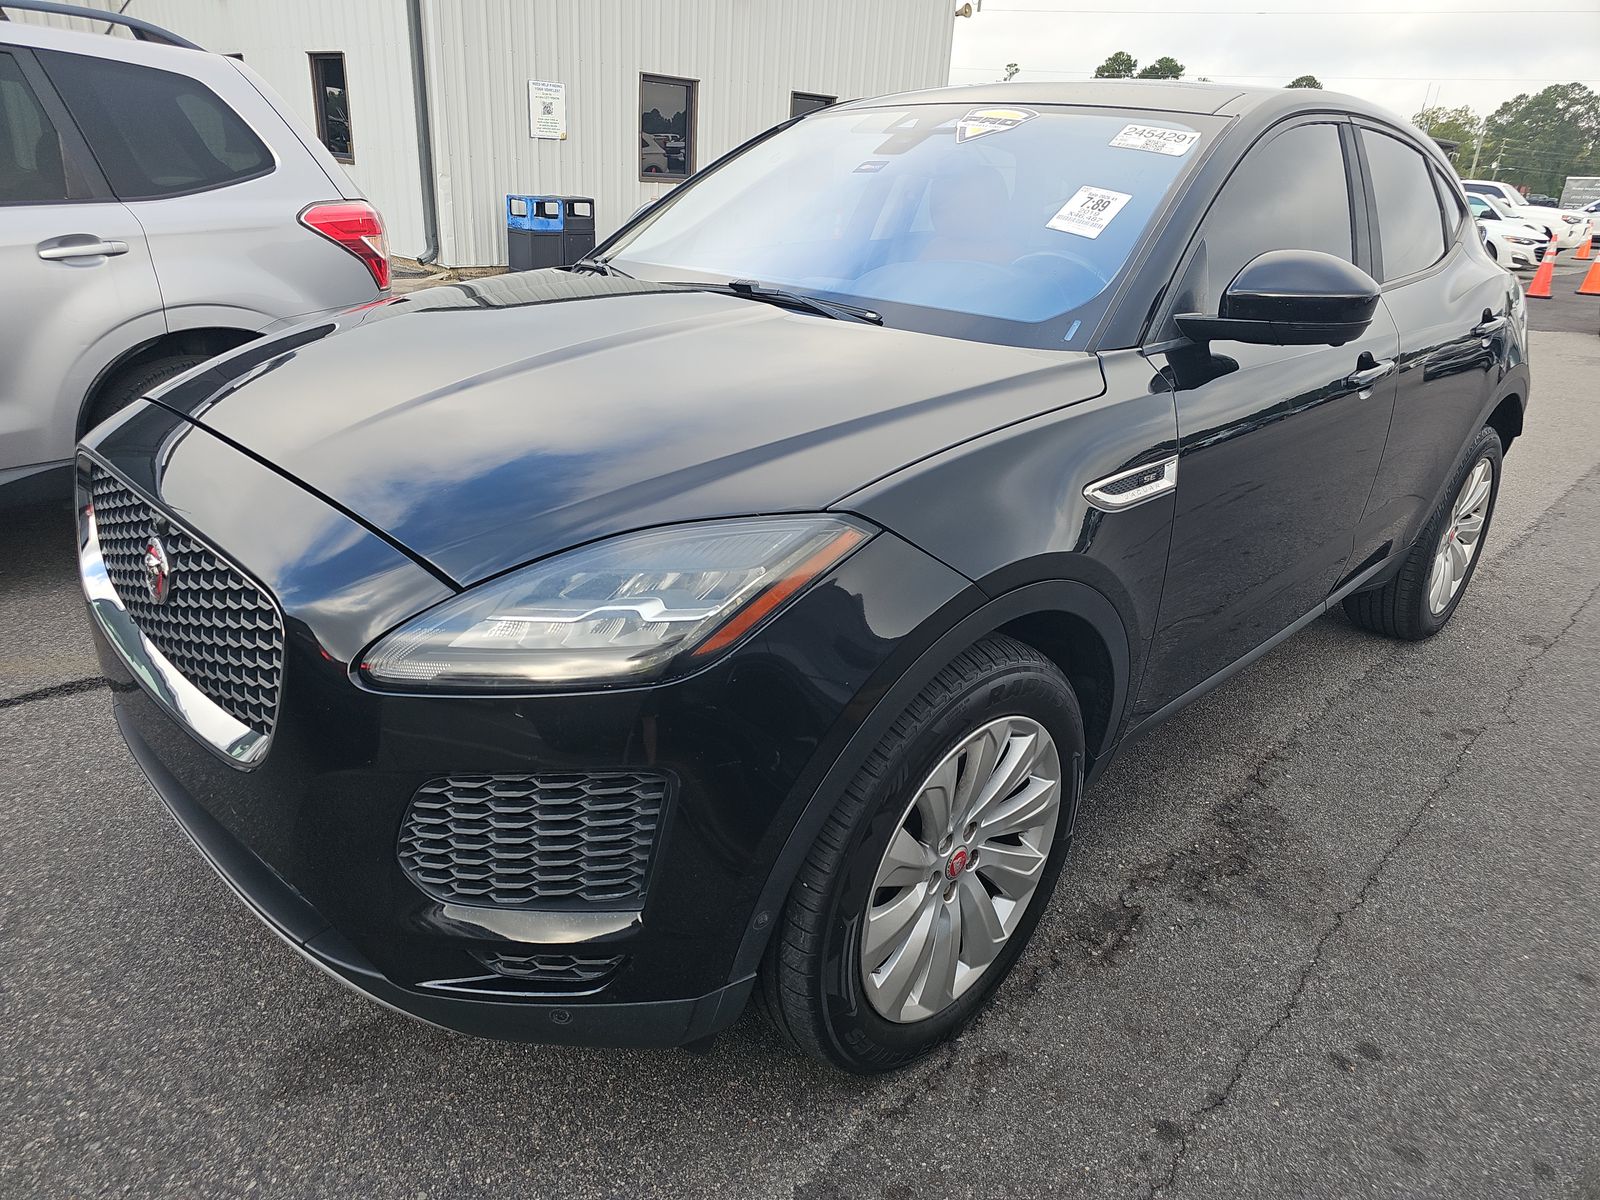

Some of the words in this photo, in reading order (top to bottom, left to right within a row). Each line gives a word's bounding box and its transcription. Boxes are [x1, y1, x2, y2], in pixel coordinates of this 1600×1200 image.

[1123, 127, 1196, 145] 2454291
[1078, 207, 1101, 217] 2019
[1080, 196, 1112, 212] 7:89
[1143, 473, 1157, 483] SE
[1125, 482, 1161, 500] JAGUAR
